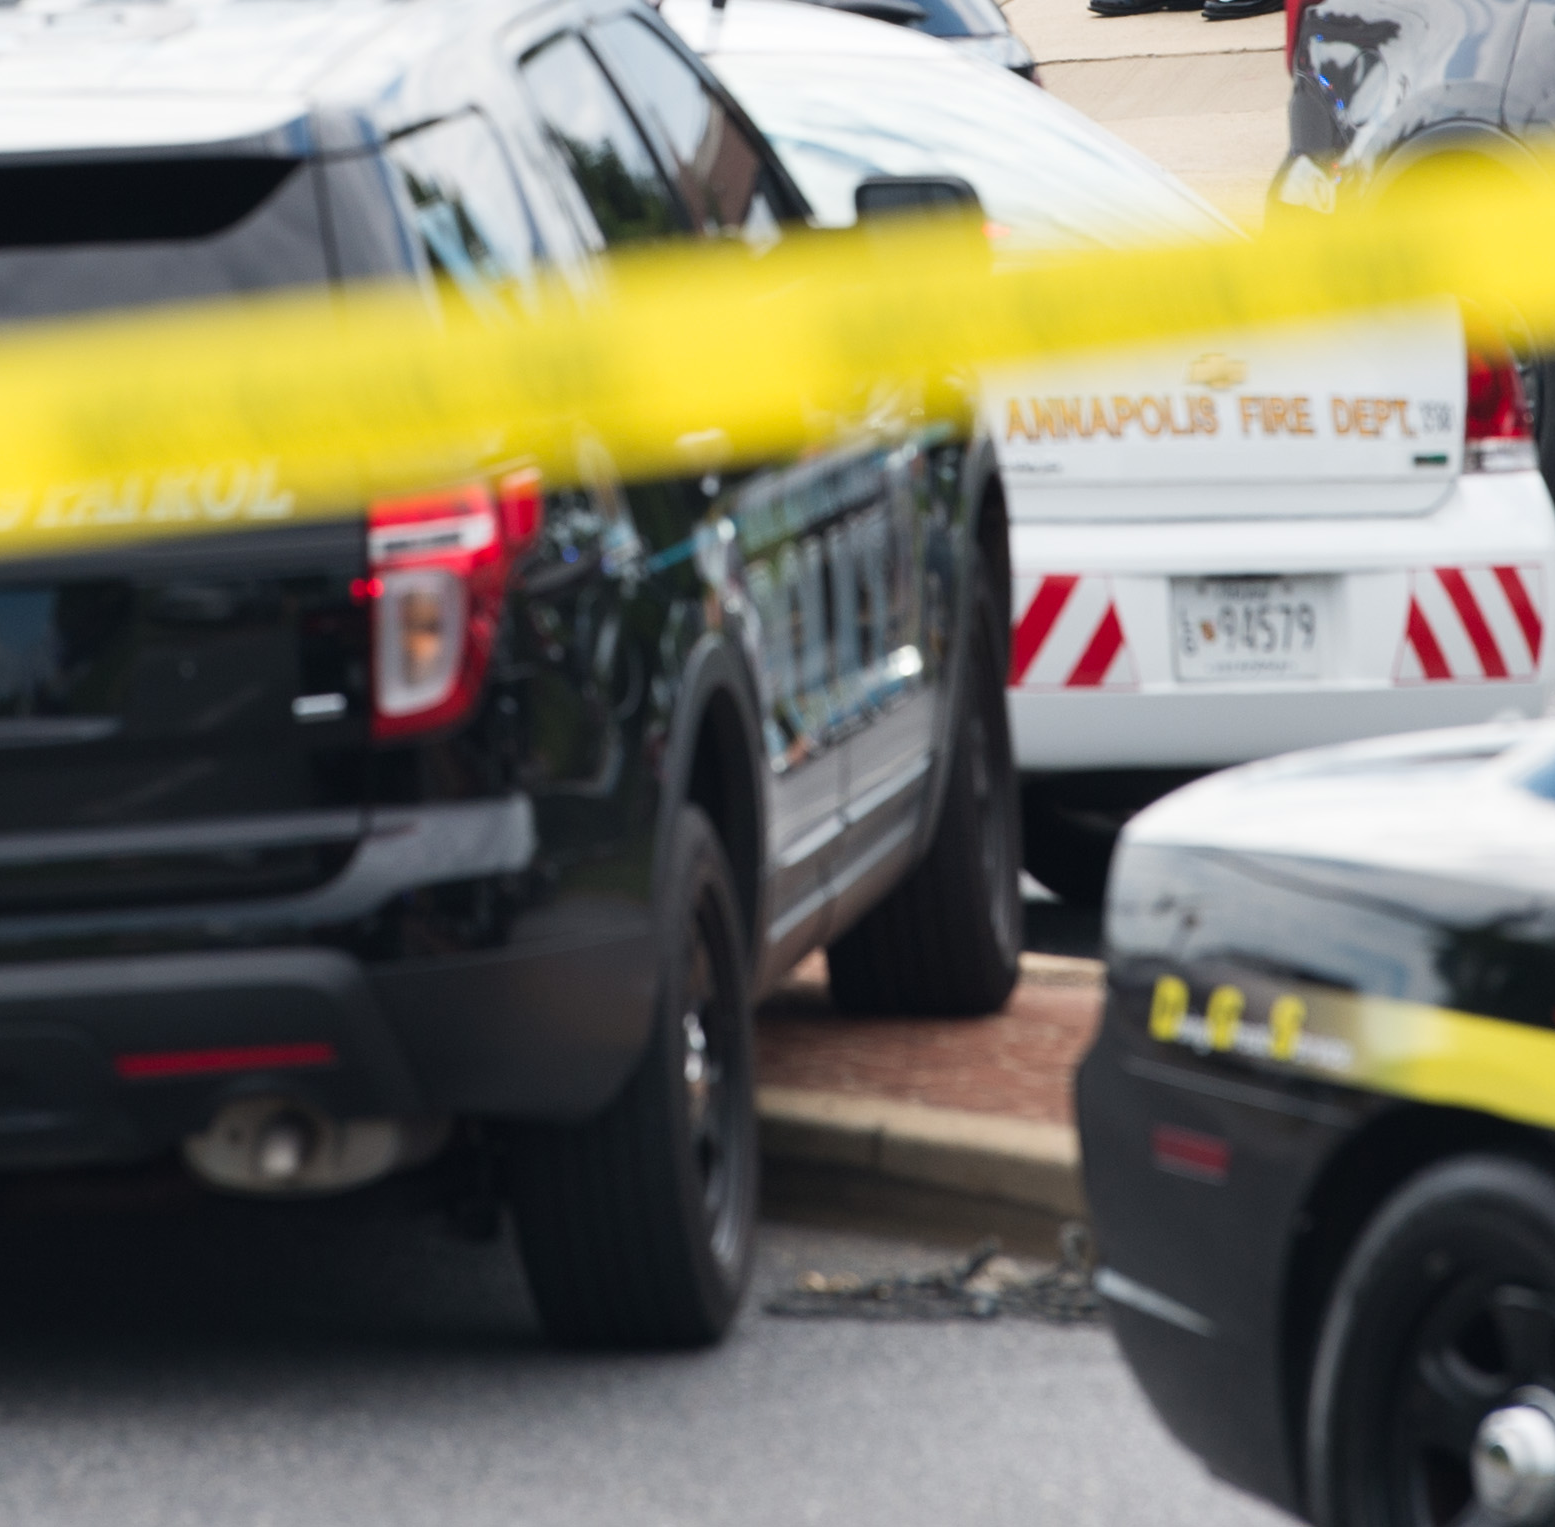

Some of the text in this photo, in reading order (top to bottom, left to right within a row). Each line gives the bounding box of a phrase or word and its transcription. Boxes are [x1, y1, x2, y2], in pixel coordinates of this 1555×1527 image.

[1006, 396, 1219, 442] ANNAPOLIS
[1240, 397, 1314, 436] FIRE
[1331, 396, 1417, 438] DEPT.
